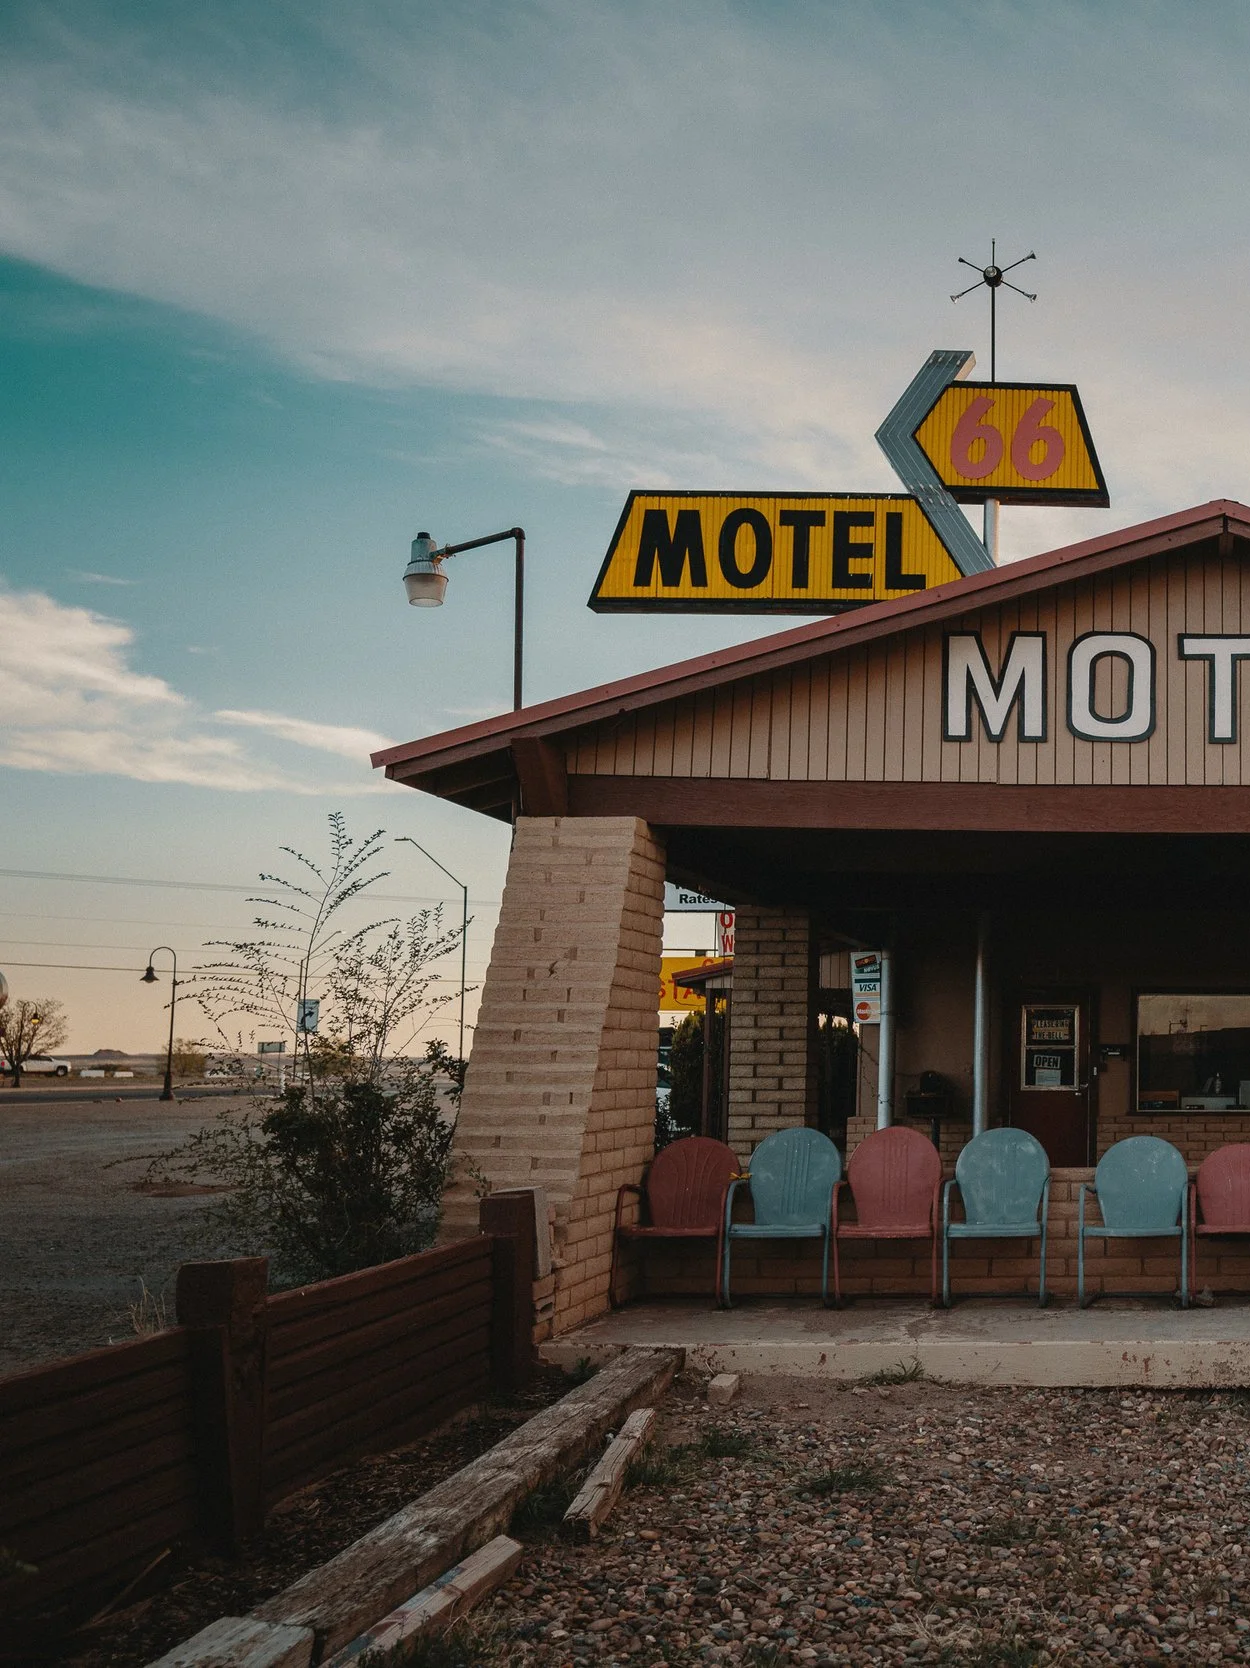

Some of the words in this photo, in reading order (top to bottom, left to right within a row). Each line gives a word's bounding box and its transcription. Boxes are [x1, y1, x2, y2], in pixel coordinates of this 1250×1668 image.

[950, 396, 1065, 481] 66
[633, 508, 926, 590] MOTEL
[1035, 1056, 1059, 1068] OPEN
